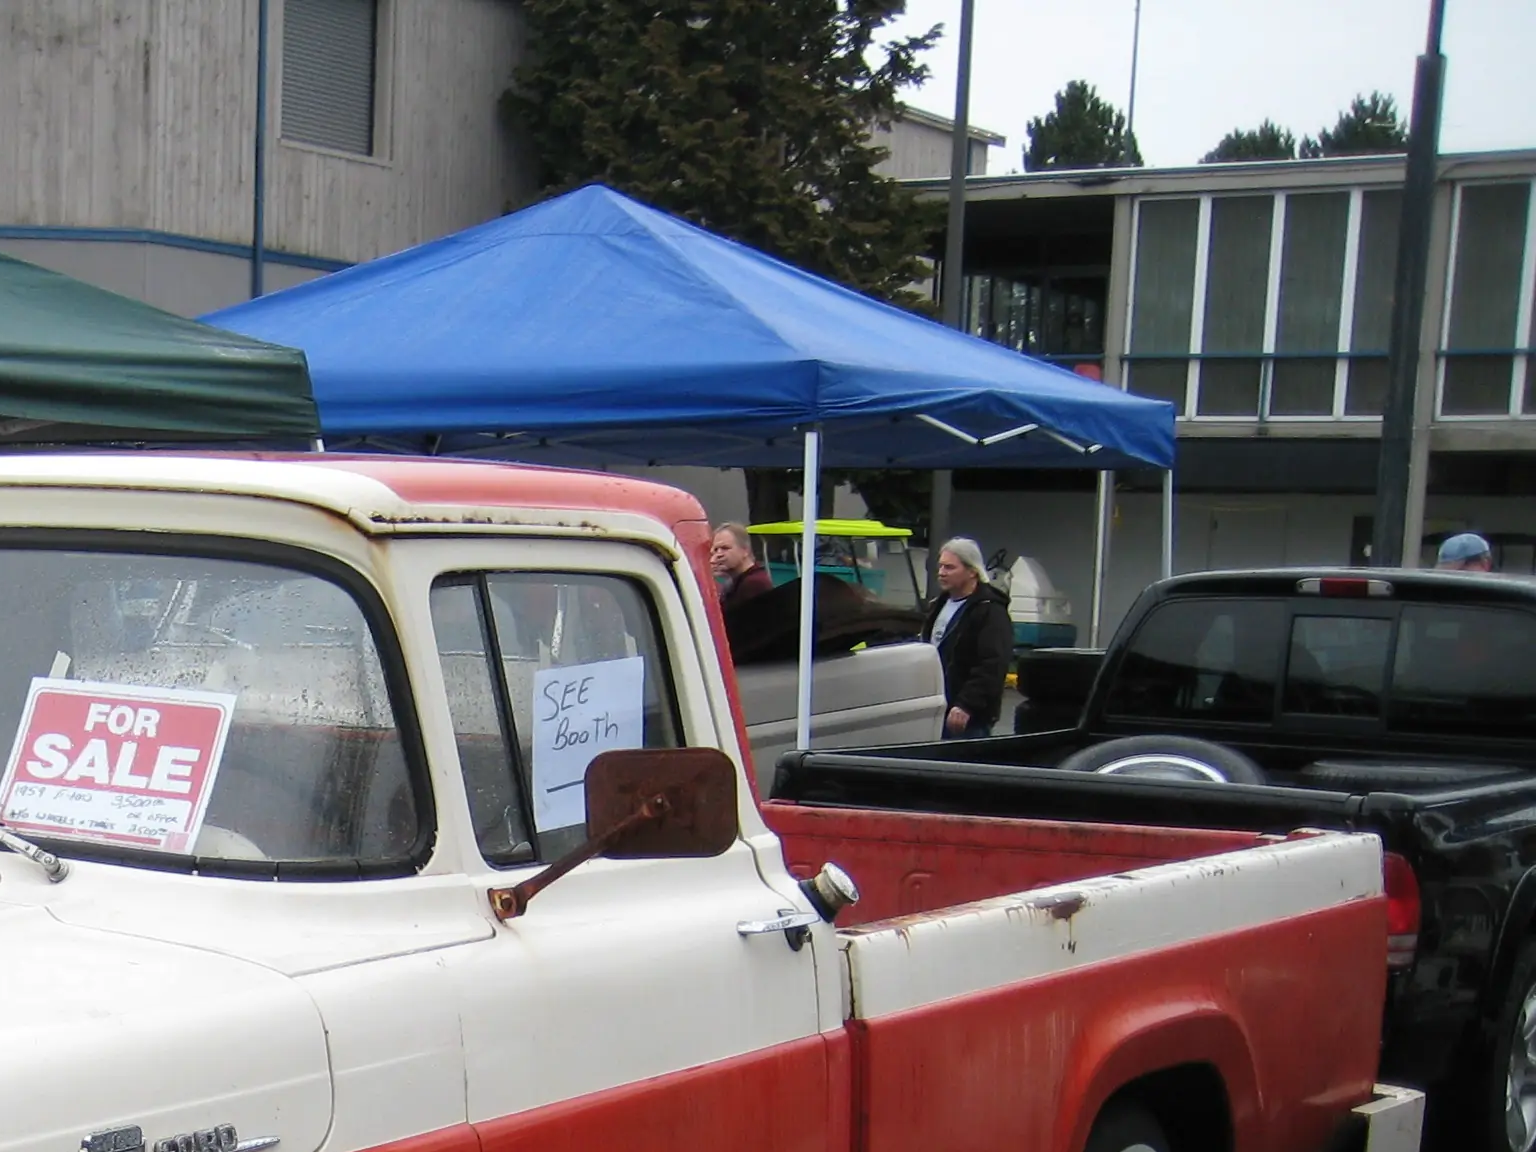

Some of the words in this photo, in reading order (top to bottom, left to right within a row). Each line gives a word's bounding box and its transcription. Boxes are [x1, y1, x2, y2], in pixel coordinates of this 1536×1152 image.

[84, 703, 160, 738] FOR
[542, 676, 595, 722] SEE
[26, 732, 201, 794] SALE
